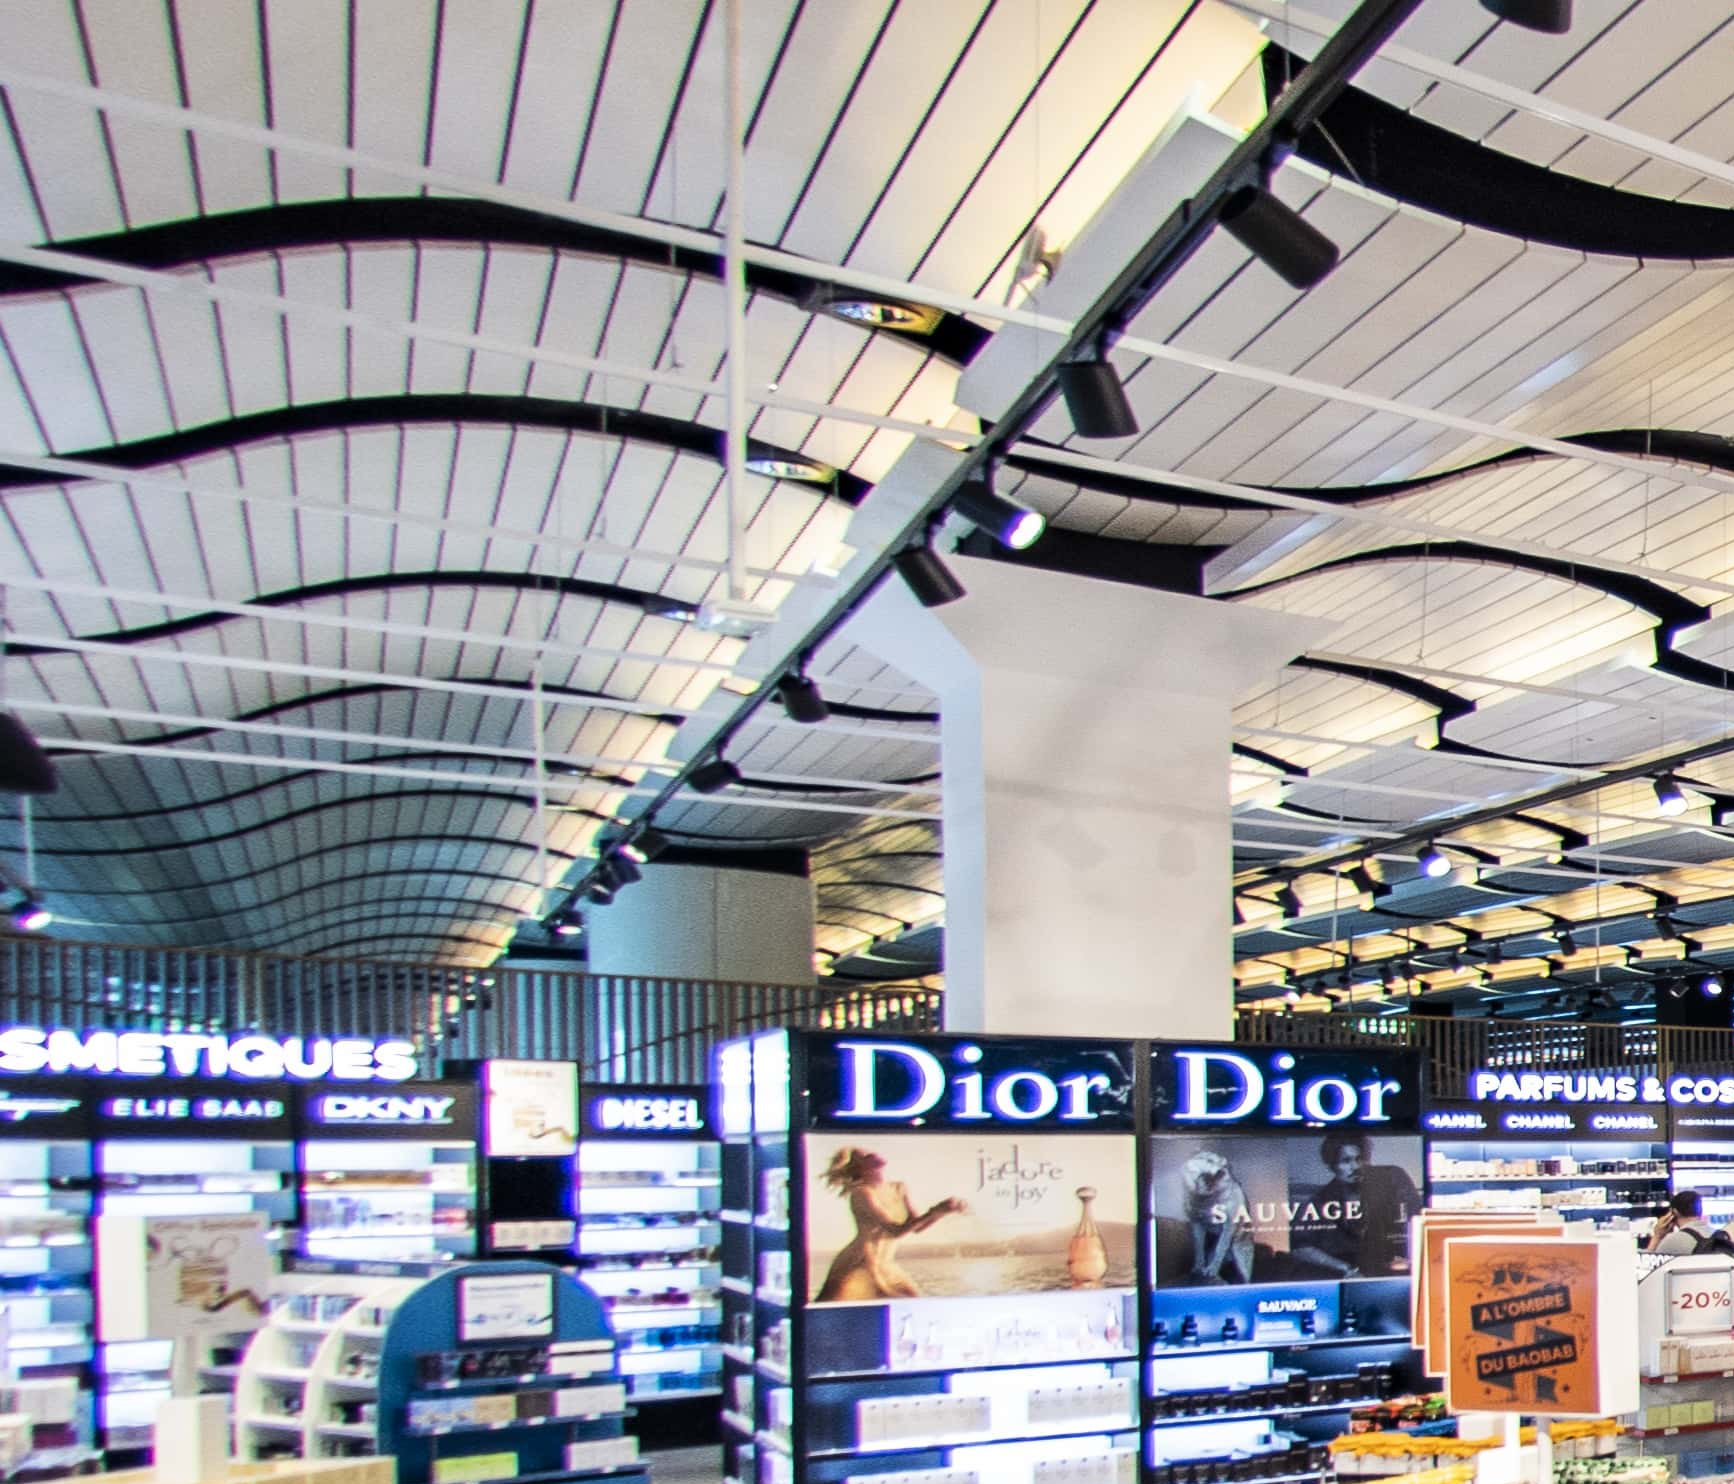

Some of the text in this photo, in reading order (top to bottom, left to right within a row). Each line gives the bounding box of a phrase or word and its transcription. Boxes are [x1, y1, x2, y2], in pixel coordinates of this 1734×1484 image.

[837, 1043, 1110, 1121] Dior
[1173, 1051, 1400, 1122] Dior
[1476, 1074, 1636, 1101] PARFUMS
[1642, 1078, 1666, 1102] &
[112, 1099, 284, 1118] ELIE SAAB
[322, 1096, 455, 1123] DKNY
[603, 1099, 703, 1129] DIESEL
[1506, 1115, 1575, 1129] CHANEL
[1593, 1117, 1658, 1129] CHANEL
[1211, 1201, 1363, 1224] SAUVAGE
[1479, 1293, 1565, 1322] A L'OMBRE
[1673, 1290, 1731, 1310] -20%
[1480, 1344, 1575, 1374] DU BAOBAB
